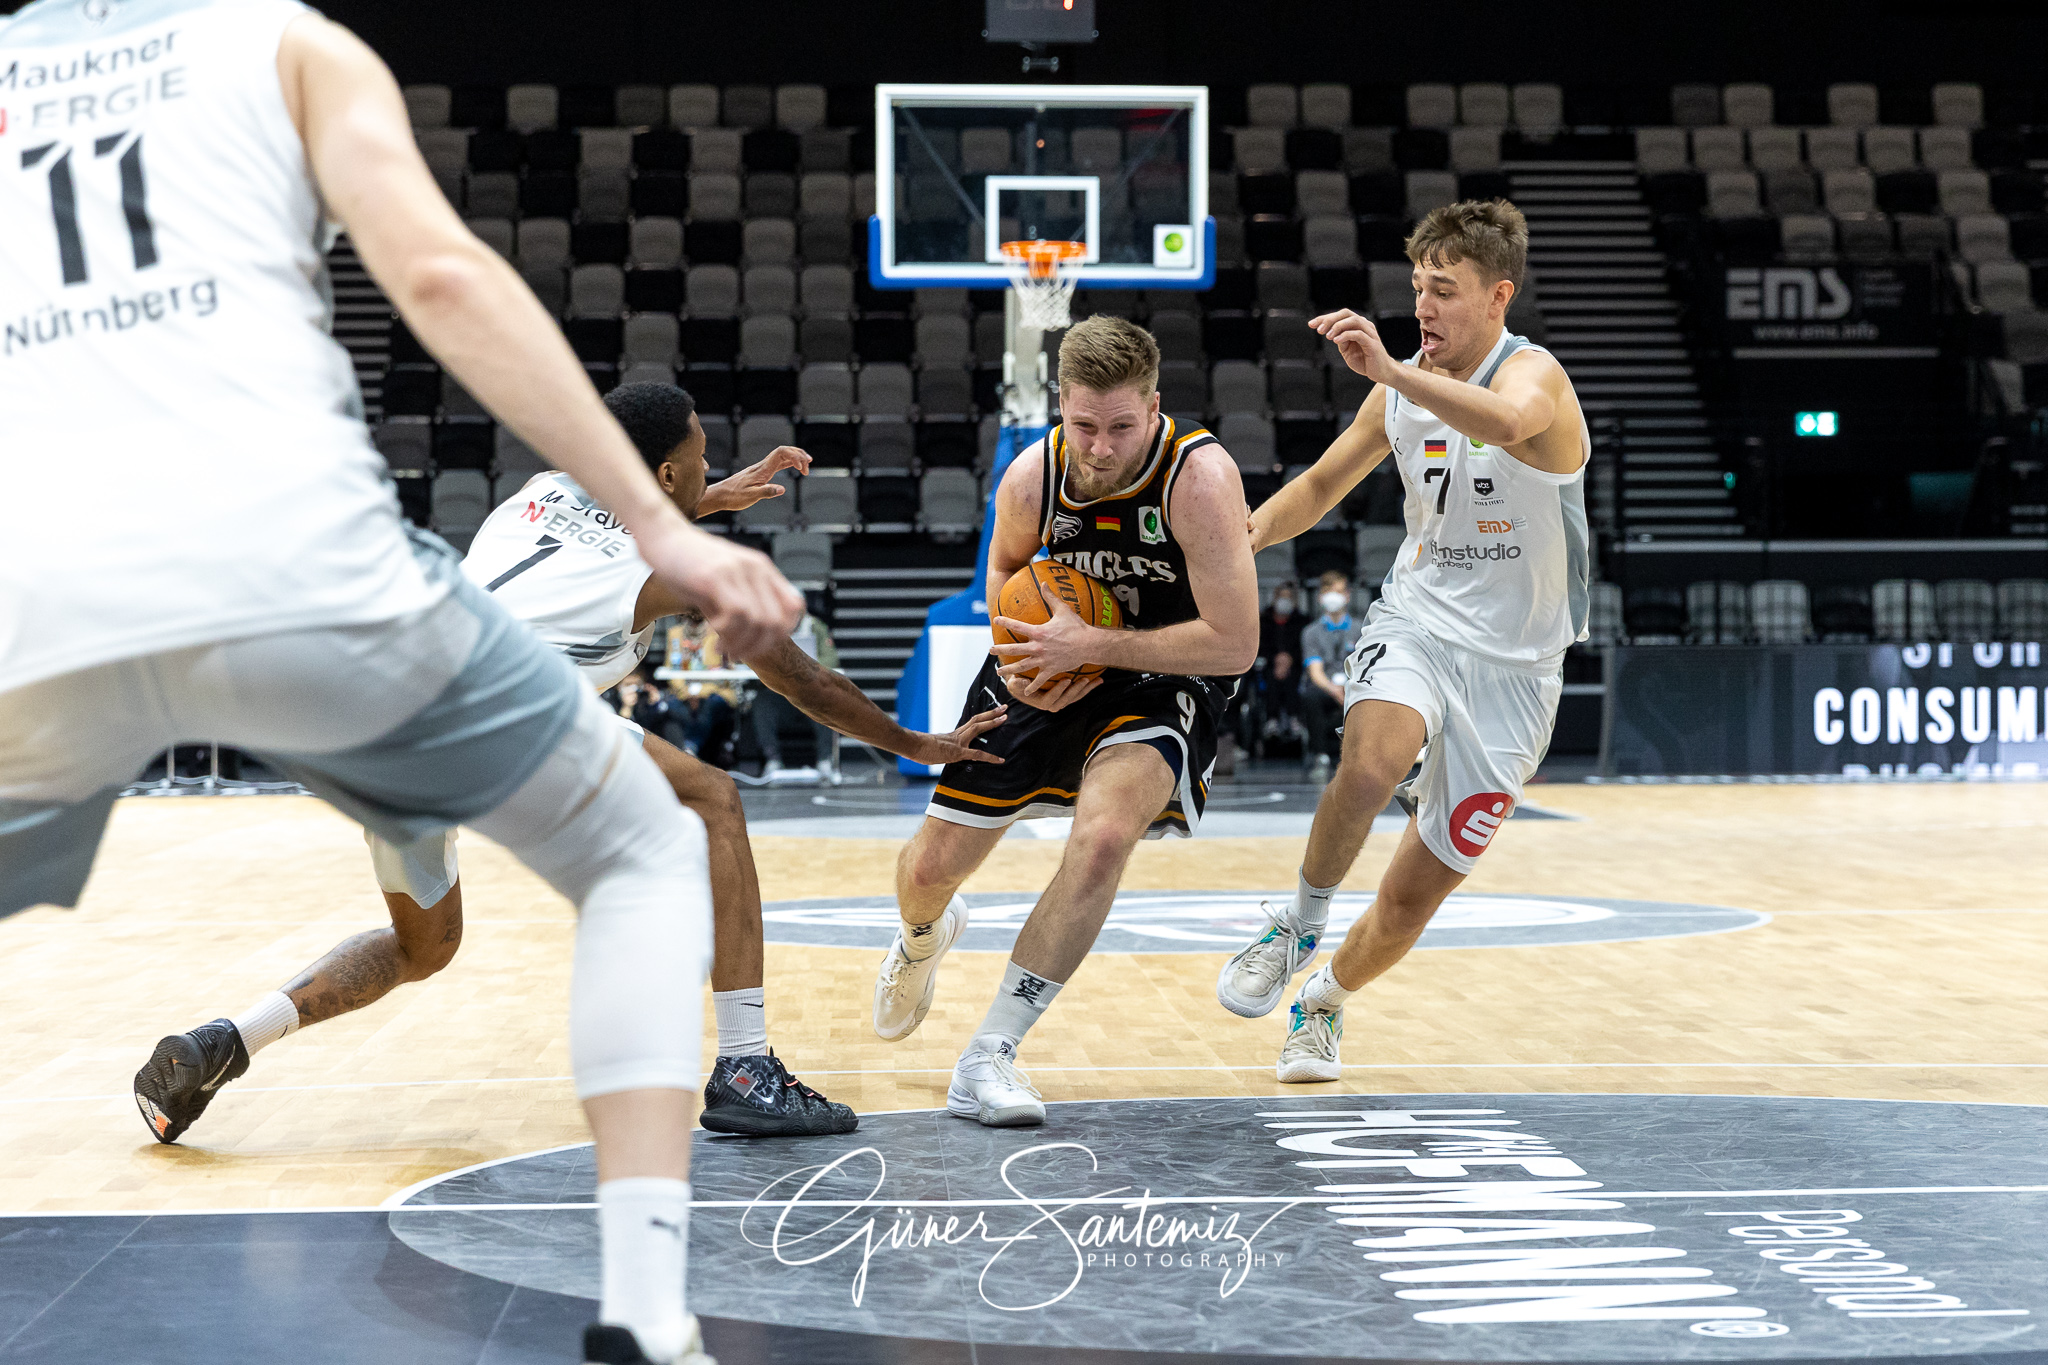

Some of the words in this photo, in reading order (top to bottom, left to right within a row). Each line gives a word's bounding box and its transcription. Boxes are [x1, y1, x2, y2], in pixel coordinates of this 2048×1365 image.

[20, 130, 159, 286] 11
[1726, 267, 1851, 320] EMS
[1423, 467, 1451, 515] 7
[1476, 520, 1512, 534] EMS
[1112, 584, 1140, 617] 9
[1176, 691, 1196, 735] 9
[1814, 686, 2048, 745] CONSUM
[1704, 1209, 2031, 1318] Personal
